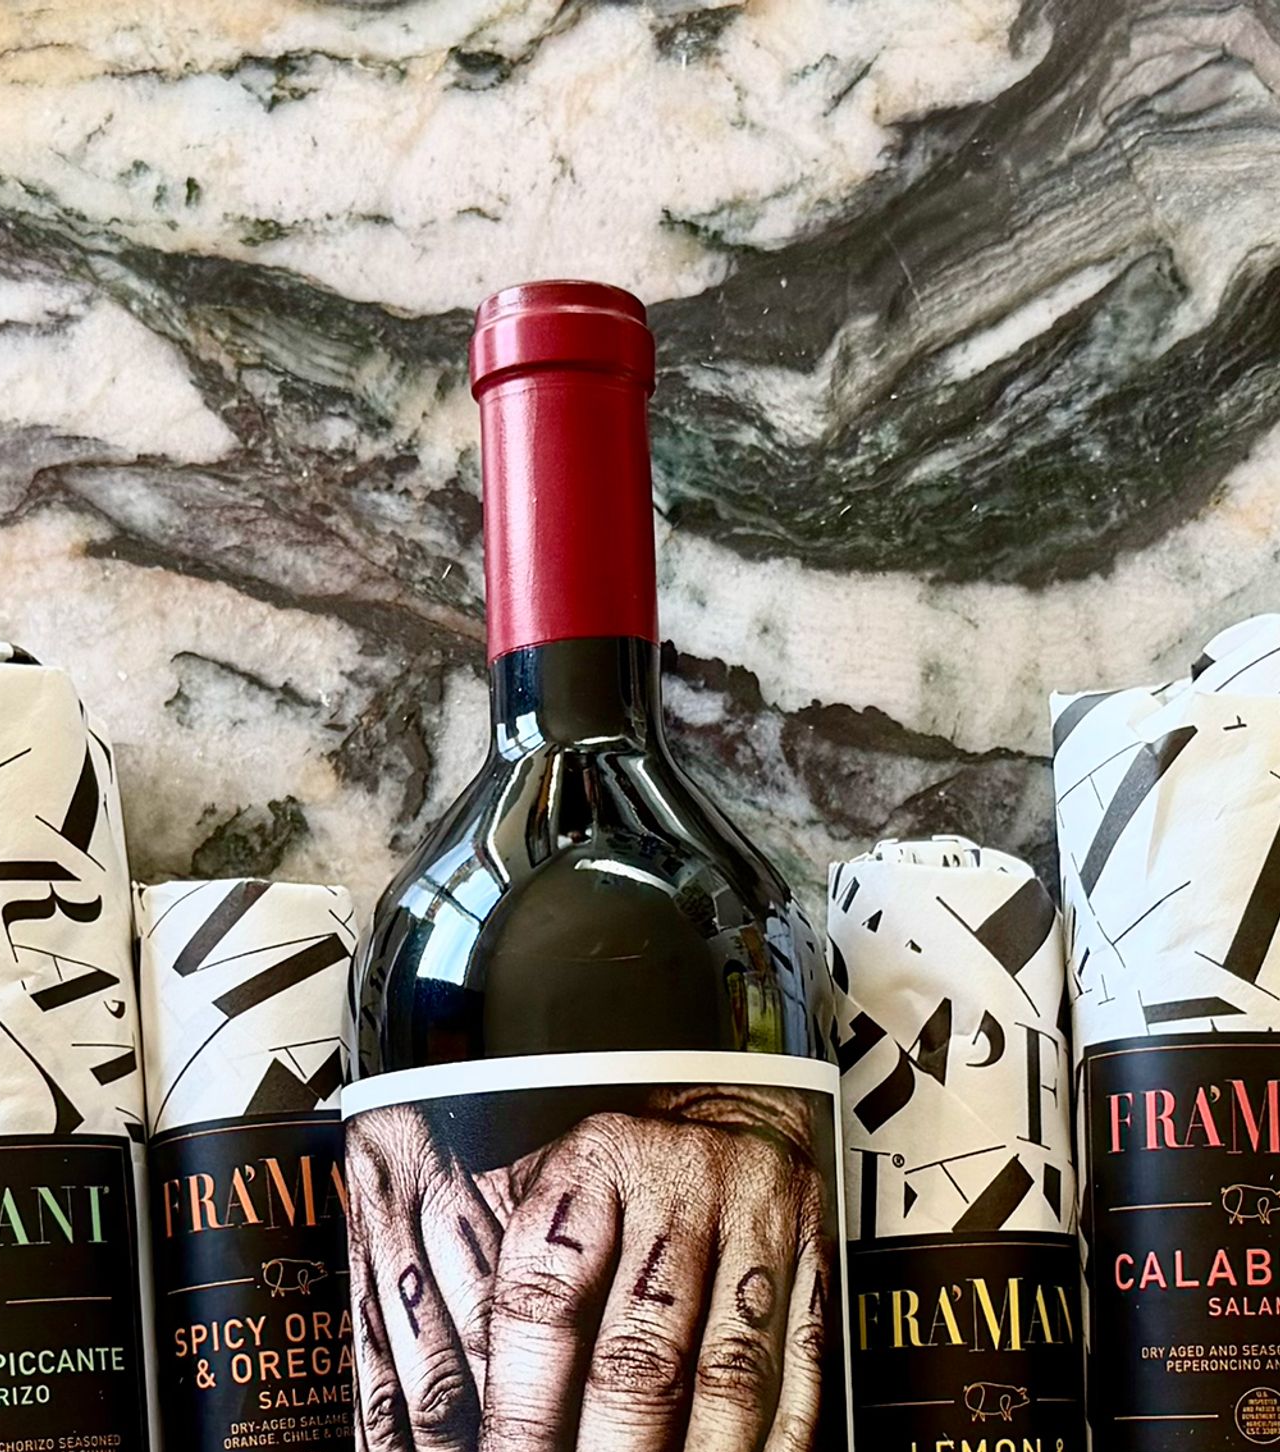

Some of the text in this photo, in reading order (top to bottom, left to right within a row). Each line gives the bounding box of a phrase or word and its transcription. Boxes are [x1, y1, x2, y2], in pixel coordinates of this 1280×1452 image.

[173, 1316, 269, 1357] SPICY
[1141, 1347, 1163, 1359] DRY
[1169, 1346, 1203, 1357] AGED
[1209, 1345, 1237, 1356] AND
[1166, 1359, 1260, 1371] PEPERONCINO
[194, 1357, 216, 1387] &
[258, 1382, 351, 1410] SALAME
